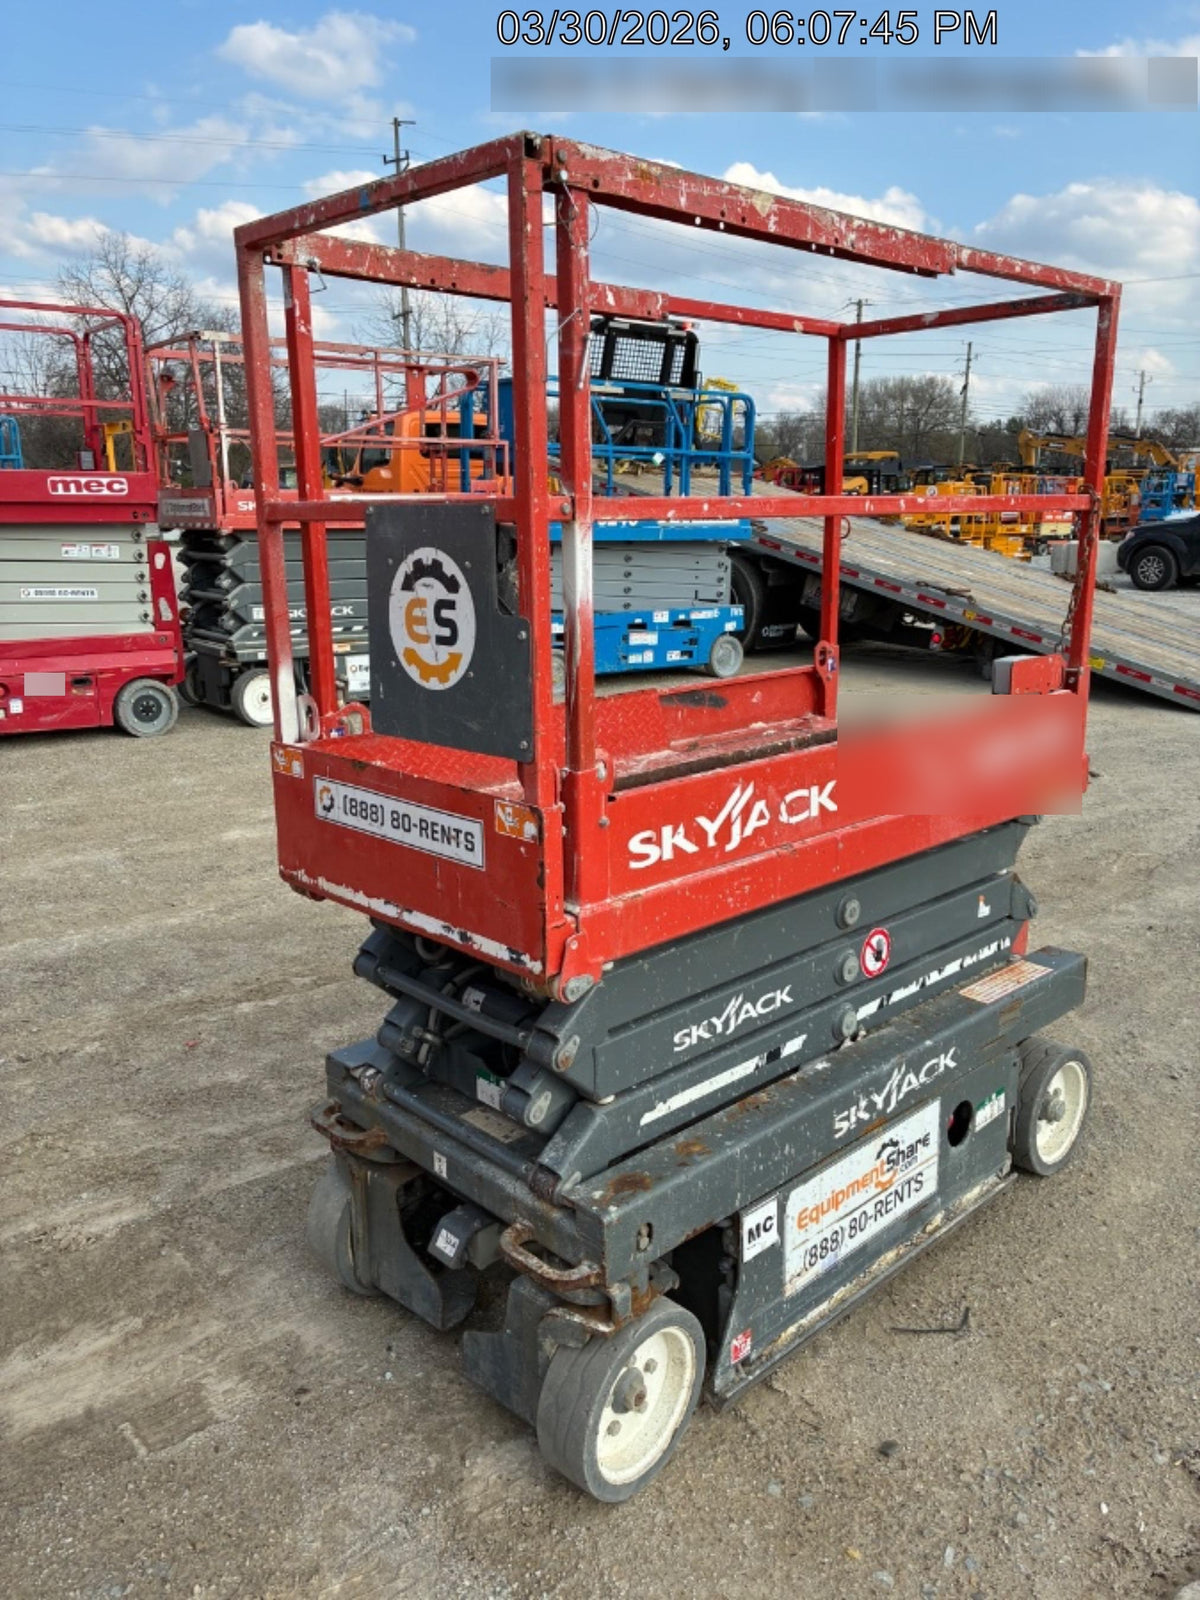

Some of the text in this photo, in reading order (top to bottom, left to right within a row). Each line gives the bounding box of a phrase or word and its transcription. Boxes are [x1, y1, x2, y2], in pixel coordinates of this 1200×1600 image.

[50, 478, 127, 494] mec
[404, 598, 459, 646] ES
[343, 794, 475, 852] (888) 80-RENTS
[627, 778, 838, 869] SKYJACK
[673, 984, 794, 1052] SKYJACK
[833, 1046, 957, 1139] SKYJACK
[747, 1215, 775, 1245] MC
[803, 1171, 924, 1272] (888) 80-RENTS
